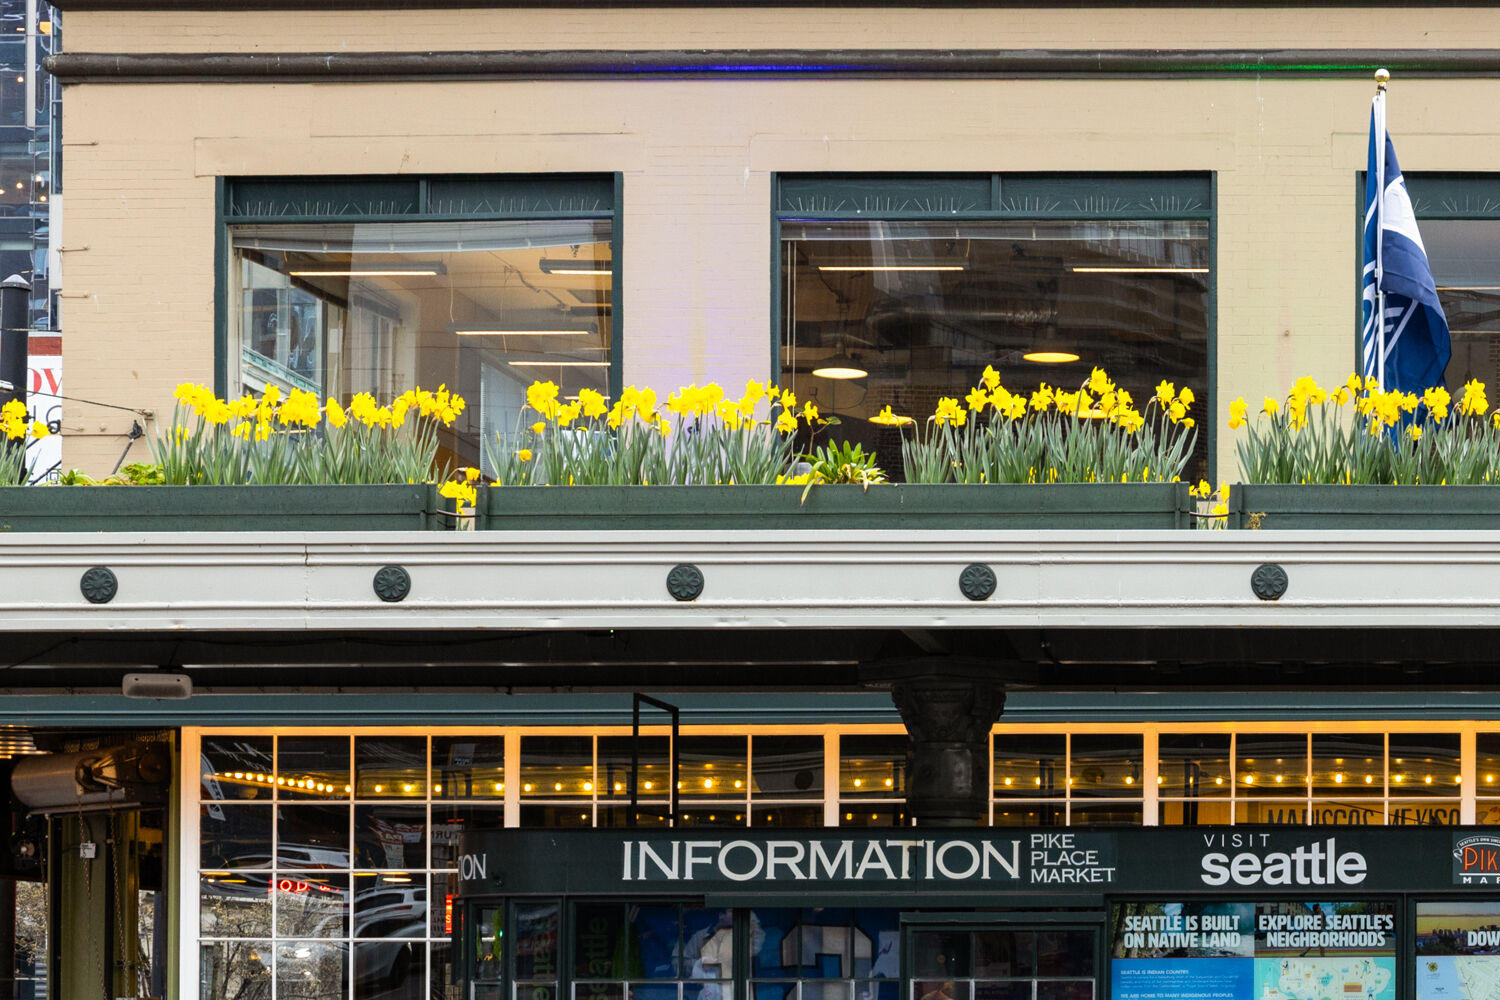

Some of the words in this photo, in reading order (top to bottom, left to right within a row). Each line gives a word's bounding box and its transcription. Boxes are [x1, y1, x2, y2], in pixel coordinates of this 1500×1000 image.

[1030, 834, 1075, 849] PIKE
[1204, 834, 1271, 848] VISIT
[622, 839, 1020, 881] INFORMATION
[1030, 850, 1098, 866] PLACE
[1201, 838, 1367, 886] seattle
[1030, 867, 1116, 883] MARKET
[1125, 915, 1182, 931] SEATTLE
[1186, 915, 1199, 931] IS
[1202, 915, 1240, 931] BUILT
[1259, 915, 1322, 931] EXPLORE
[1326, 914, 1393, 930] SEATTLE'S
[1124, 932, 1144, 948] ON
[1148, 932, 1198, 948] NATIVE
[1202, 932, 1241, 948] LAND
[1266, 932, 1386, 948] NEIGHBORHOODS
